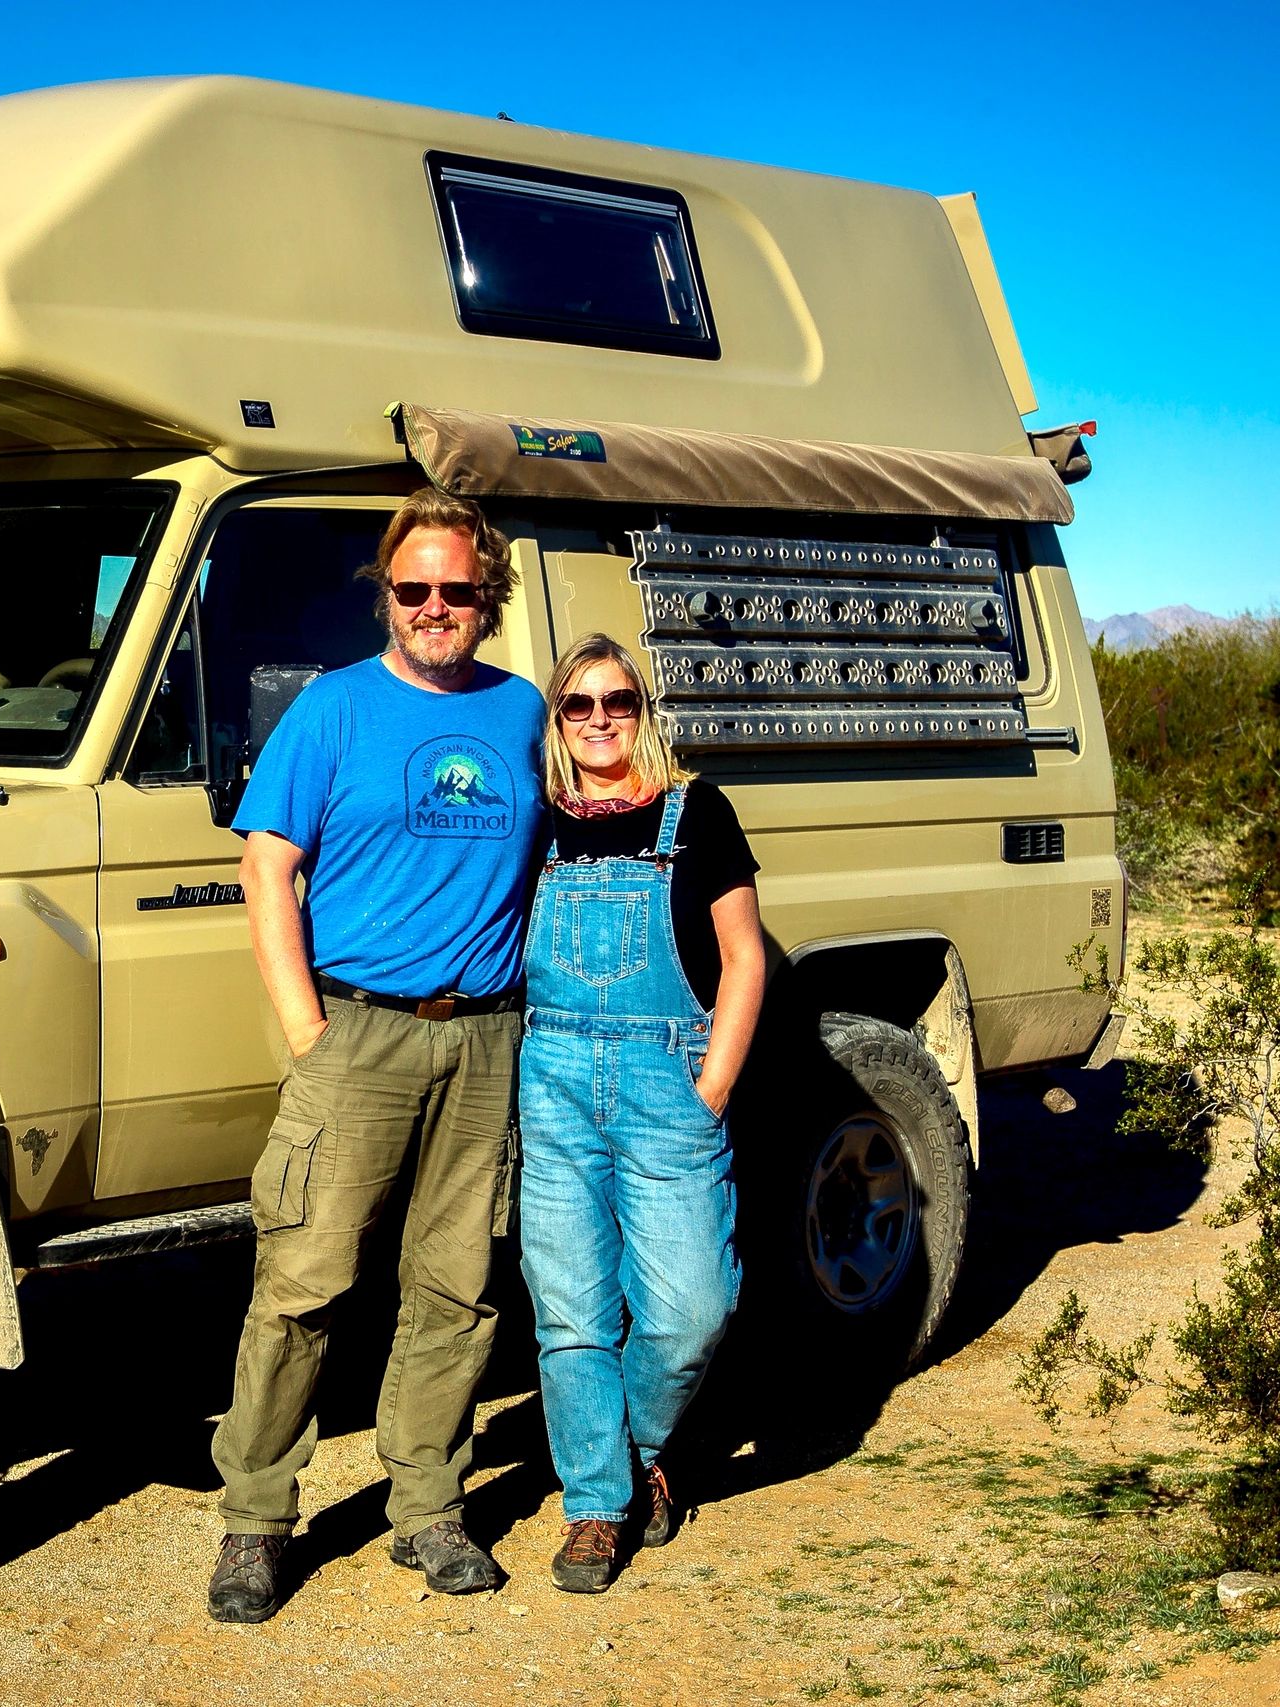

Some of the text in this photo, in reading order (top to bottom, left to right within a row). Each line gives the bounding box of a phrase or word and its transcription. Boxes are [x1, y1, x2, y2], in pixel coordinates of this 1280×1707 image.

[547, 432, 578, 452] Safari
[422, 744, 497, 780] MOUNTAIN WORKS
[414, 810, 508, 831] Marmot
[870, 1078, 929, 1122] OPEN
